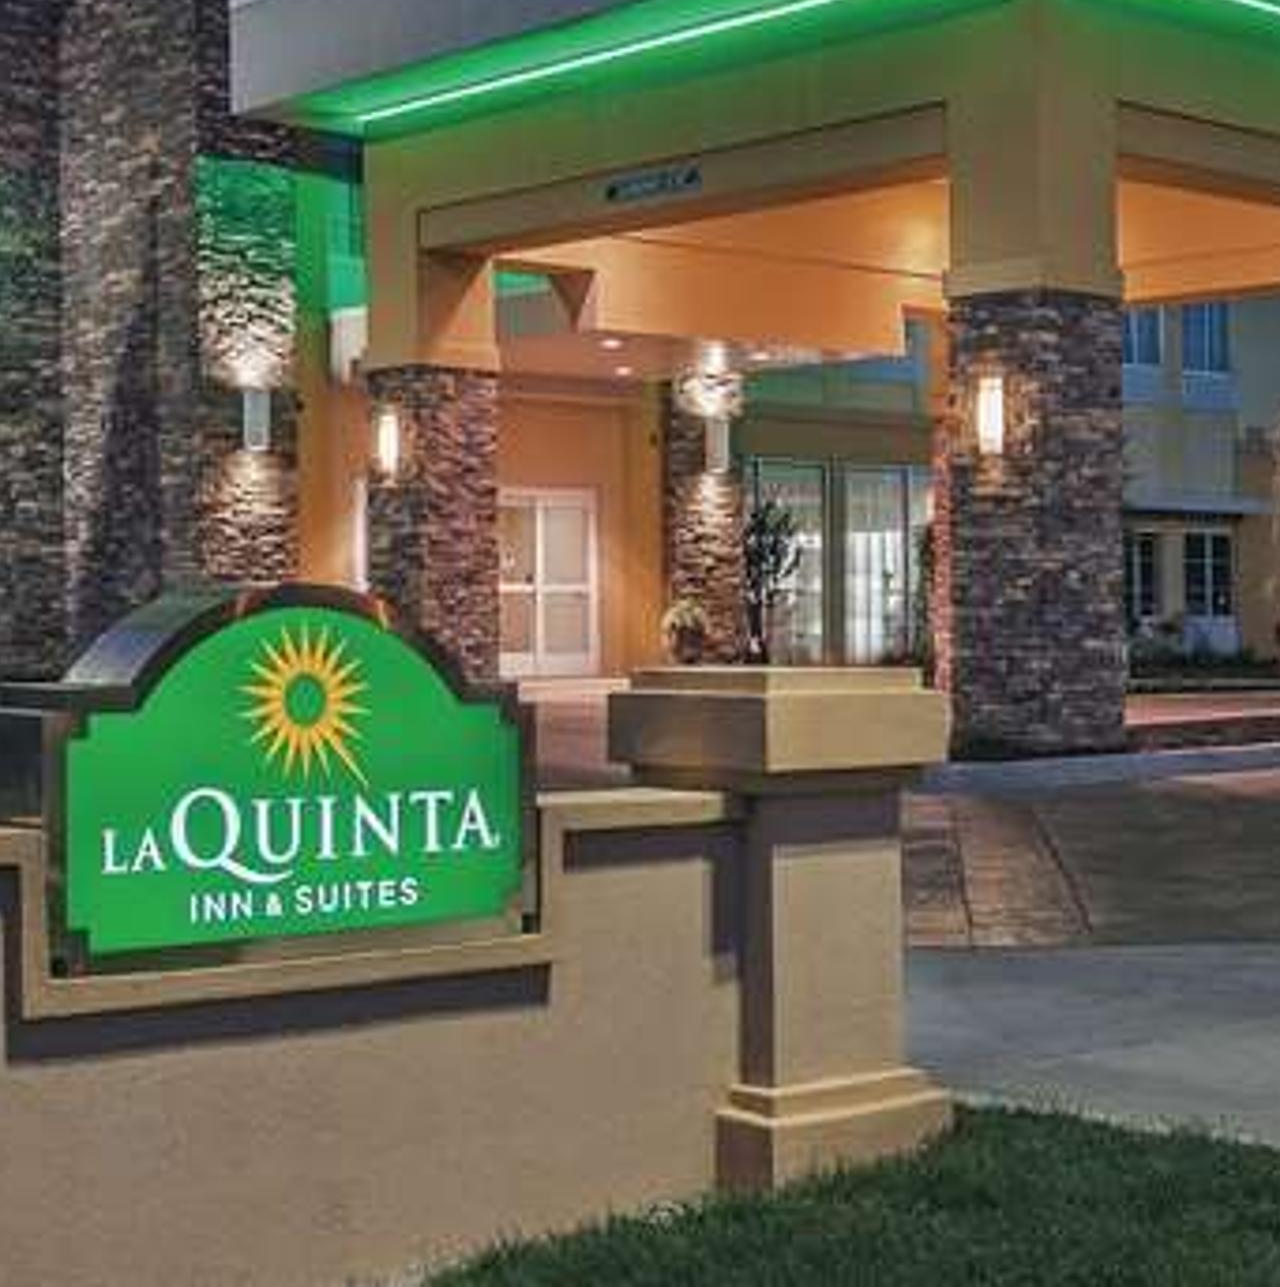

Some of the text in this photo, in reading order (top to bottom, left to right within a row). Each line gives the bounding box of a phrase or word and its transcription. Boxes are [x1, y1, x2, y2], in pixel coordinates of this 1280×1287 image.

[170, 787, 500, 884] QUINTA
[191, 877, 419, 924] INN & SUITES
